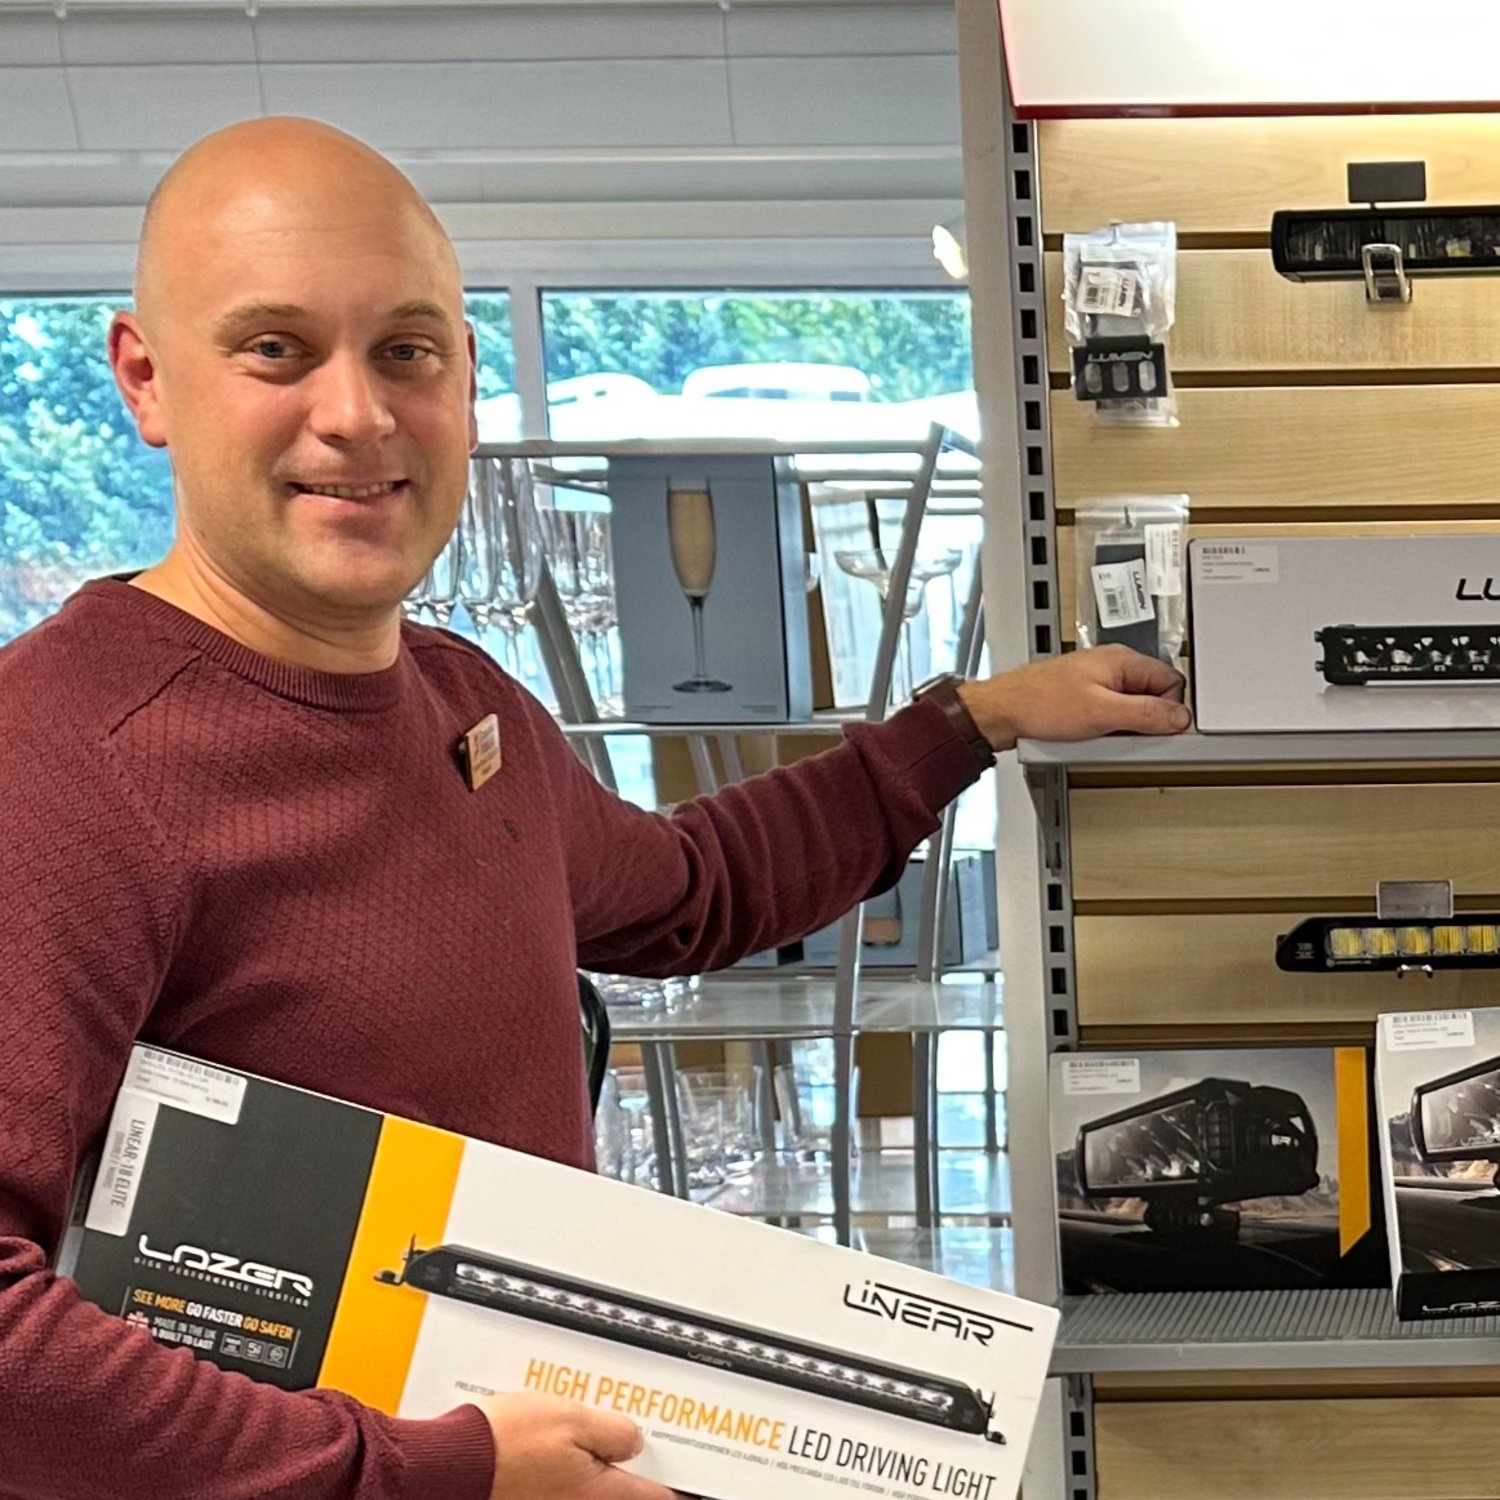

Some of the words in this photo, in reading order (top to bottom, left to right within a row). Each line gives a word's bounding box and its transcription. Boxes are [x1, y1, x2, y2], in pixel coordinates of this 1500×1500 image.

[1088, 351, 1153, 362] LUMEN
[110, 1177, 132, 1208] ELITE
[138, 1234, 313, 1297] LAZER
[132, 1289, 154, 1305] SEE
[154, 1294, 187, 1313] MORE
[186, 1302, 202, 1317] GO
[202, 1305, 244, 1328] FASTER
[243, 1316, 260, 1331] GO
[260, 1320, 294, 1340] SAFER
[524, 1358, 591, 1402] HIGH
[594, 1376, 786, 1451] PERFORMANCE
[788, 1425, 832, 1462] LED
[836, 1439, 929, 1487] DRIVING
